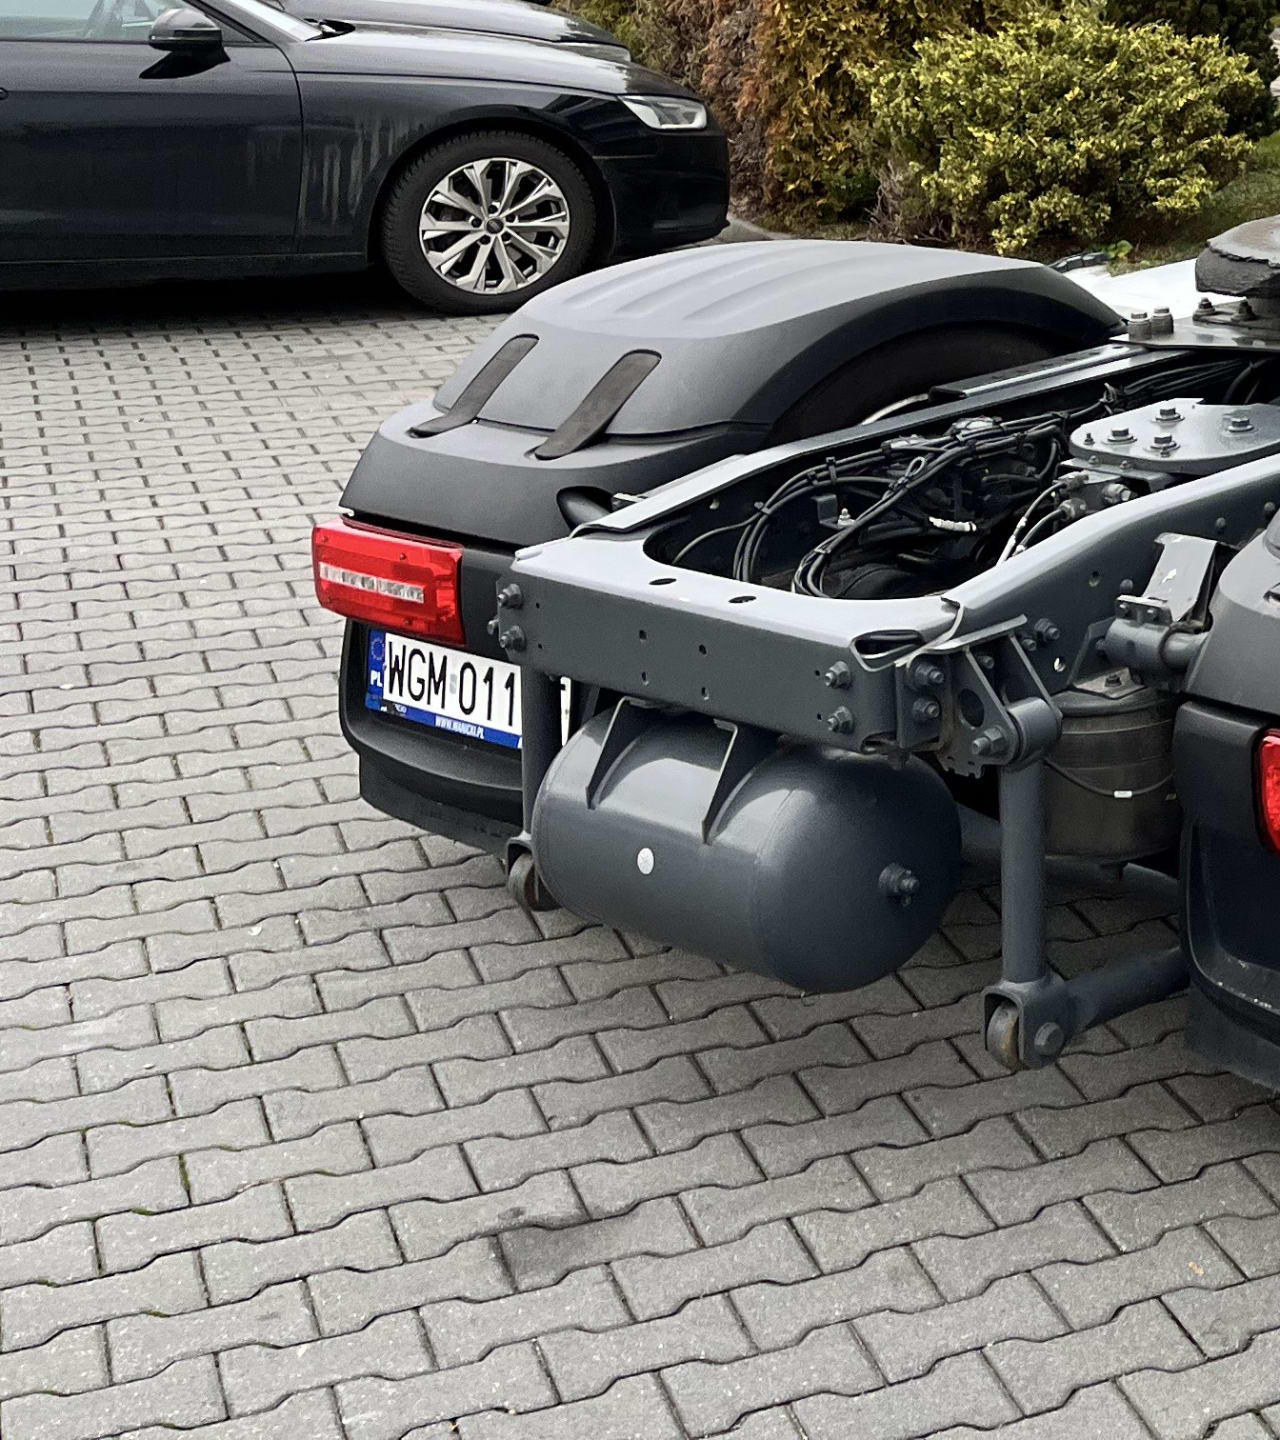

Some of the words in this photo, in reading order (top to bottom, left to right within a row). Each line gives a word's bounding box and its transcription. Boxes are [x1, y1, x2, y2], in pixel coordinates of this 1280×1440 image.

[370, 669, 383, 687] PL
[388, 641, 448, 709] WGM
[458, 662, 516, 727] 011
